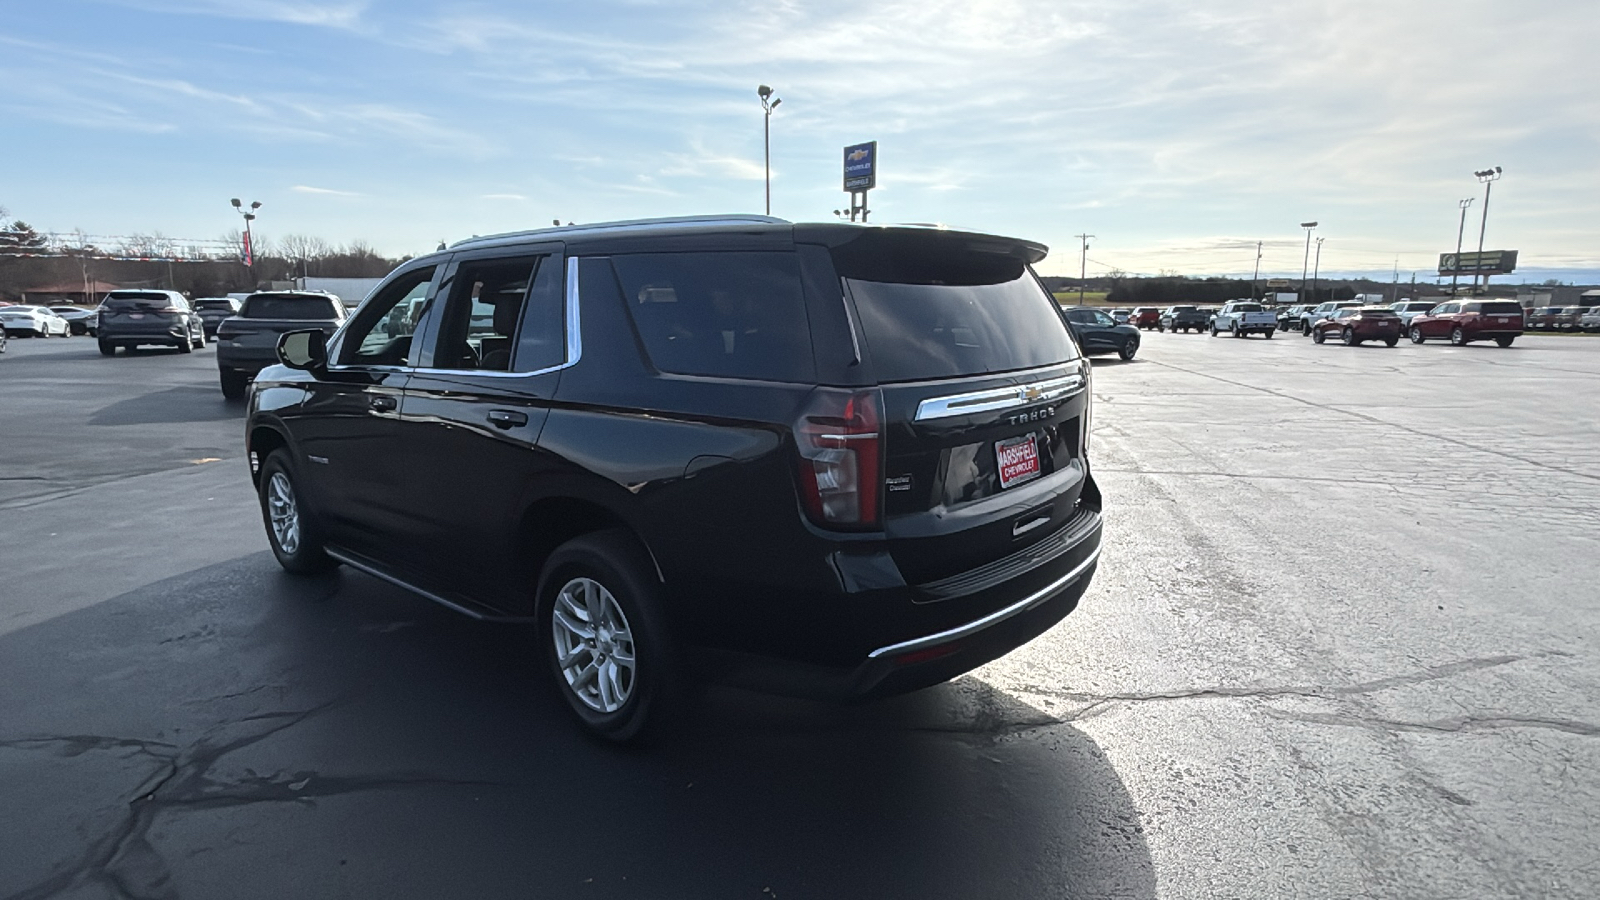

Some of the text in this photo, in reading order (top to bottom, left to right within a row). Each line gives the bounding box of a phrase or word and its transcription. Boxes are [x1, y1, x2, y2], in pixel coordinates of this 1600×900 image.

[1008, 407, 1055, 425] TAHOE
[999, 442, 1036, 467] MARSHFIELD
[1004, 459, 1034, 477] CHEVROLET
